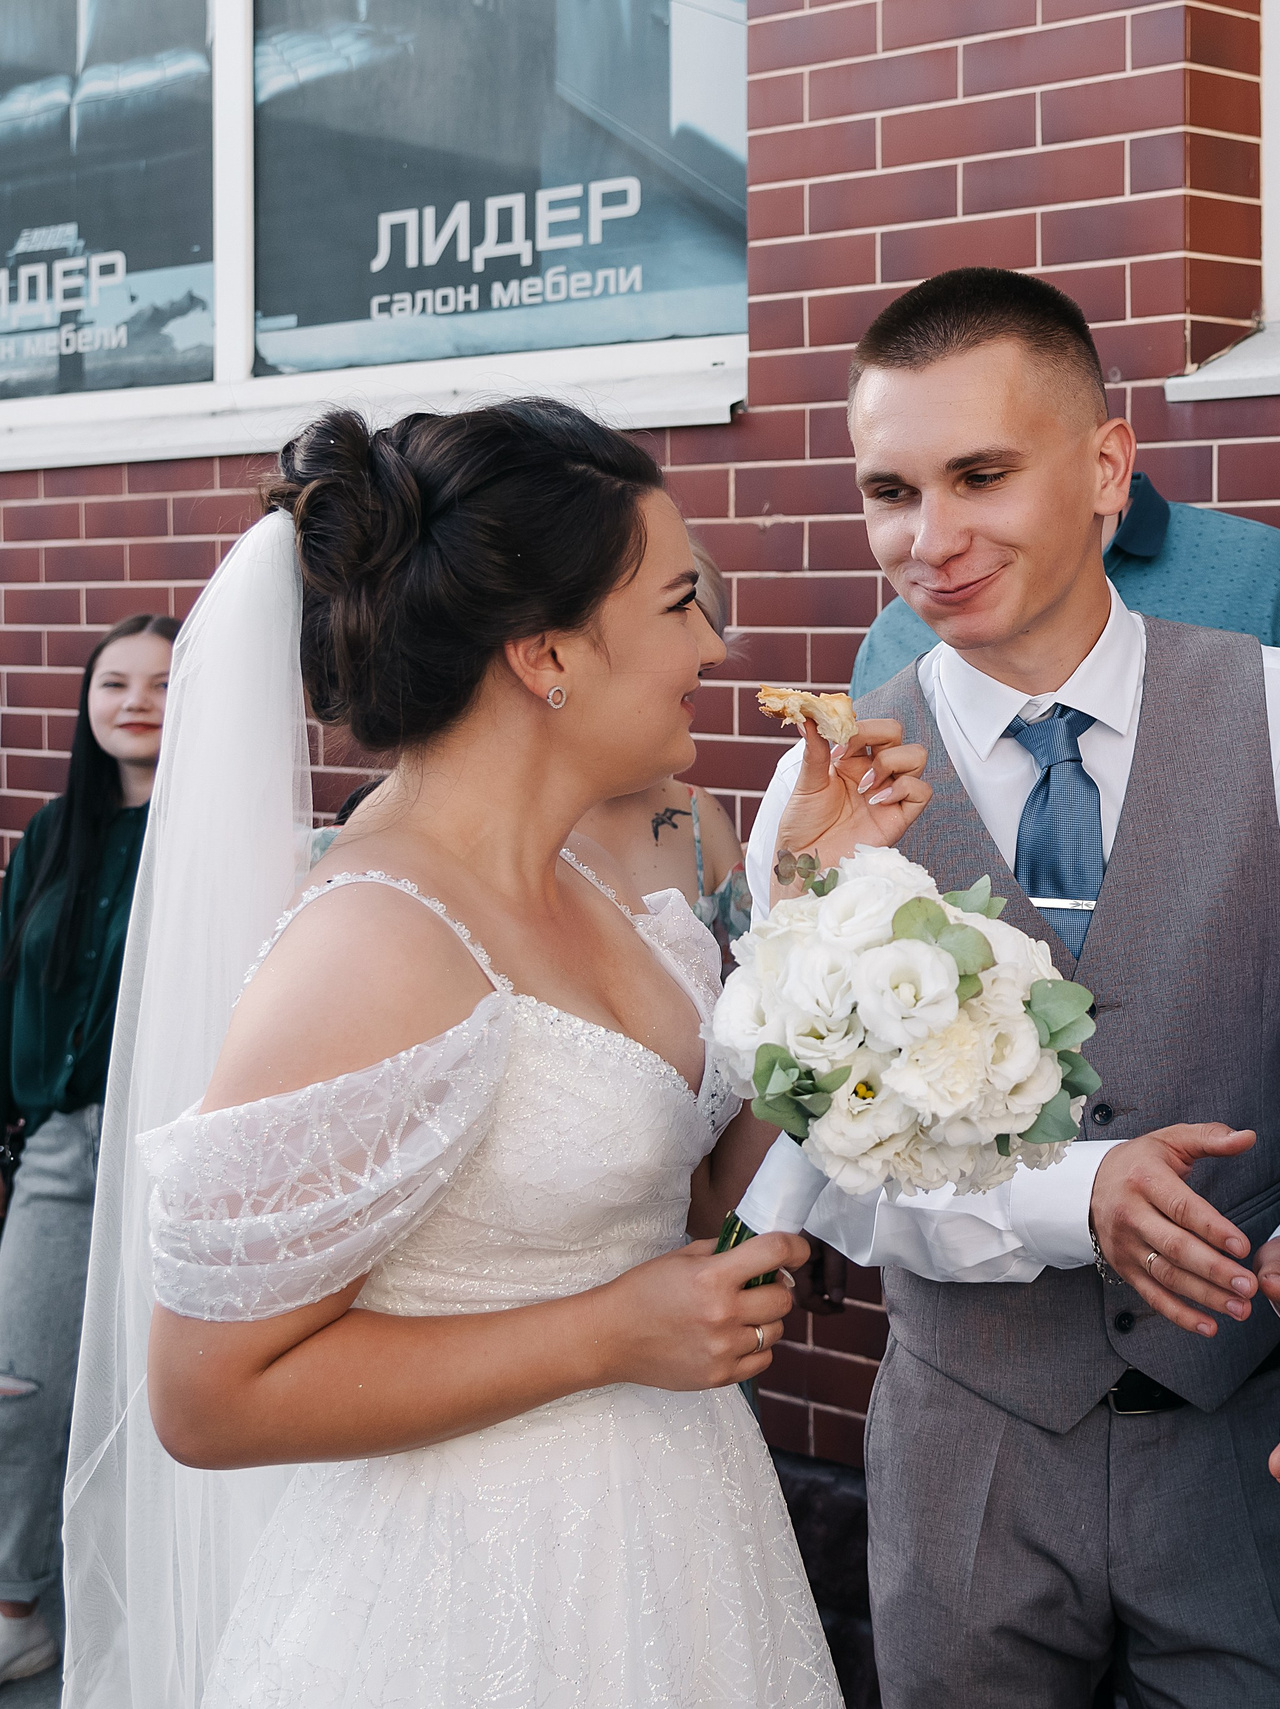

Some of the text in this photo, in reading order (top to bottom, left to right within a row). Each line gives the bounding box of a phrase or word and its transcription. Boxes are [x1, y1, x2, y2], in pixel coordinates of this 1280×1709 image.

[369, 175, 642, 274] ЛИДЕР
[0, 249, 128, 327] ДЕР
[369, 263, 644, 321] салон мебели
[23, 321, 129, 358] мебели
